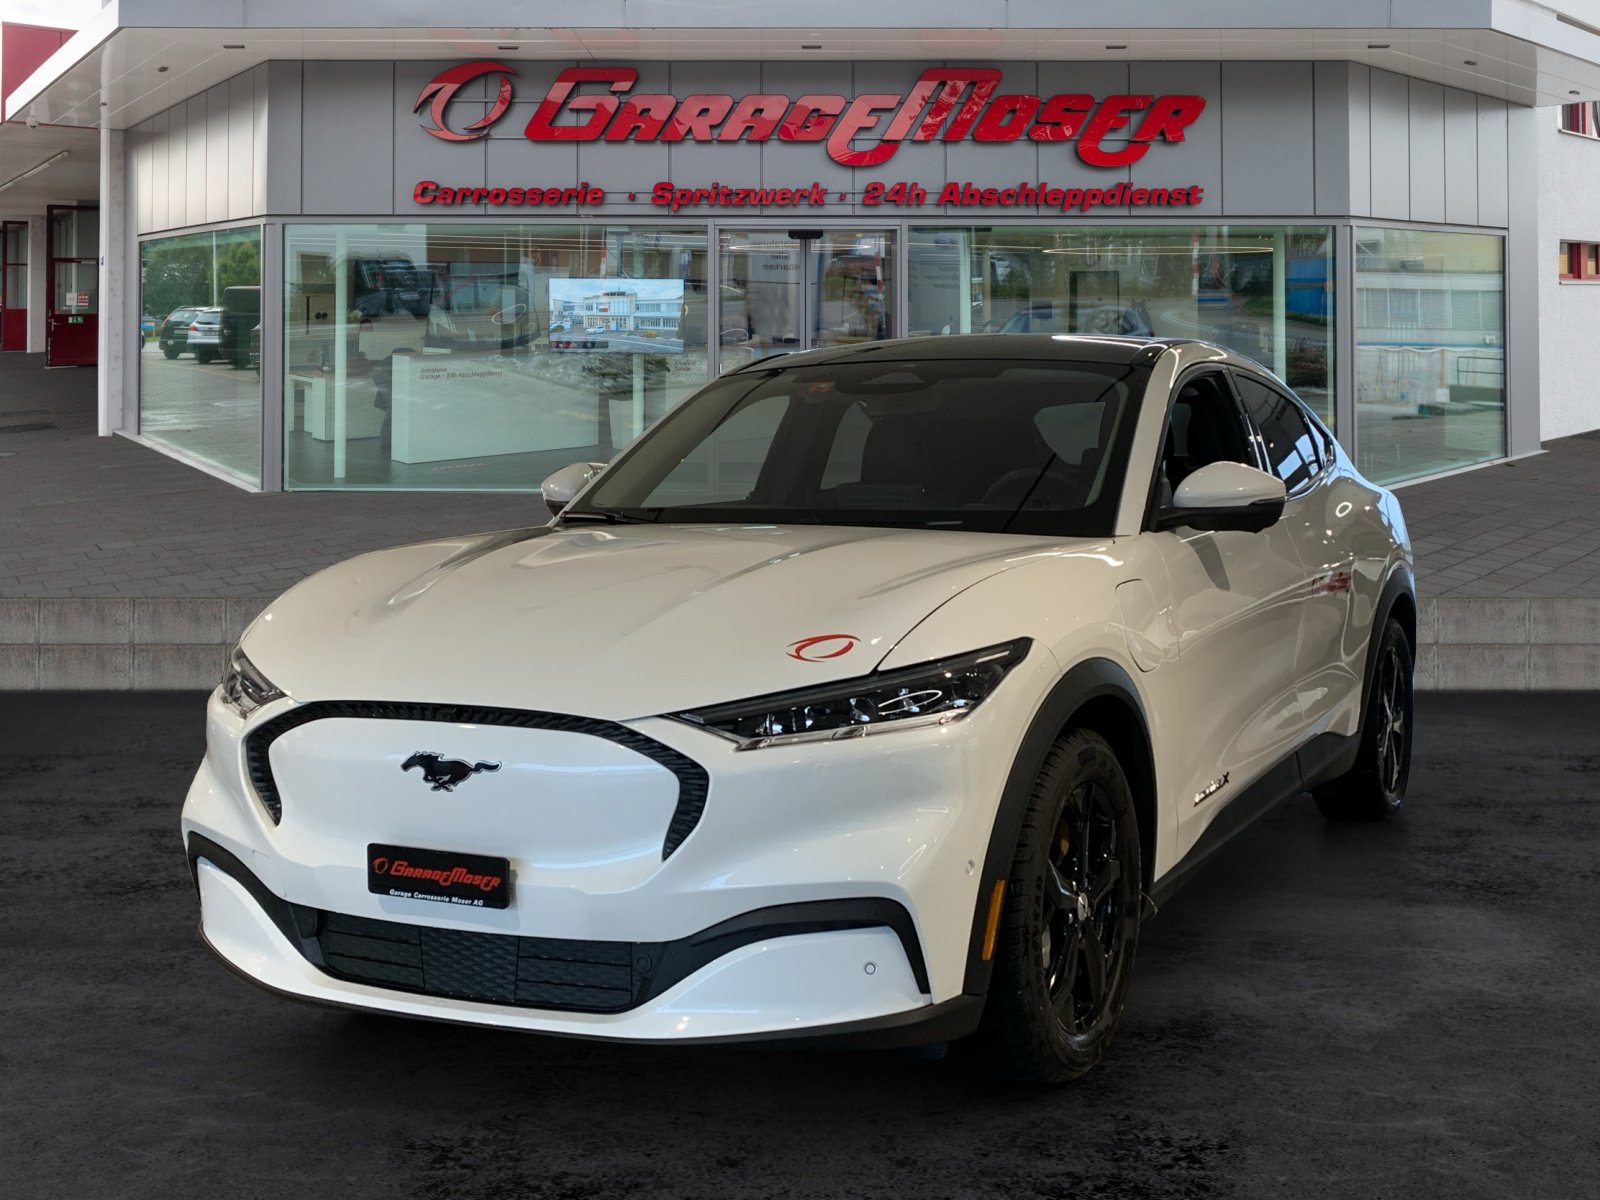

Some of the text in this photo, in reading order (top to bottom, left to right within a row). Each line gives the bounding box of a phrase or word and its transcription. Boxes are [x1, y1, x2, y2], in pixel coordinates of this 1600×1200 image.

[413, 181, 604, 206] Carrosserie
[651, 181, 827, 211] Spritzwerk
[863, 182, 927, 206] 24h
[938, 182, 1204, 211] Abschleppdienst
[389, 888, 412, 898] Garage
[413, 892, 450, 902] Carrosserie
[451, 897, 472, 905] Moser
